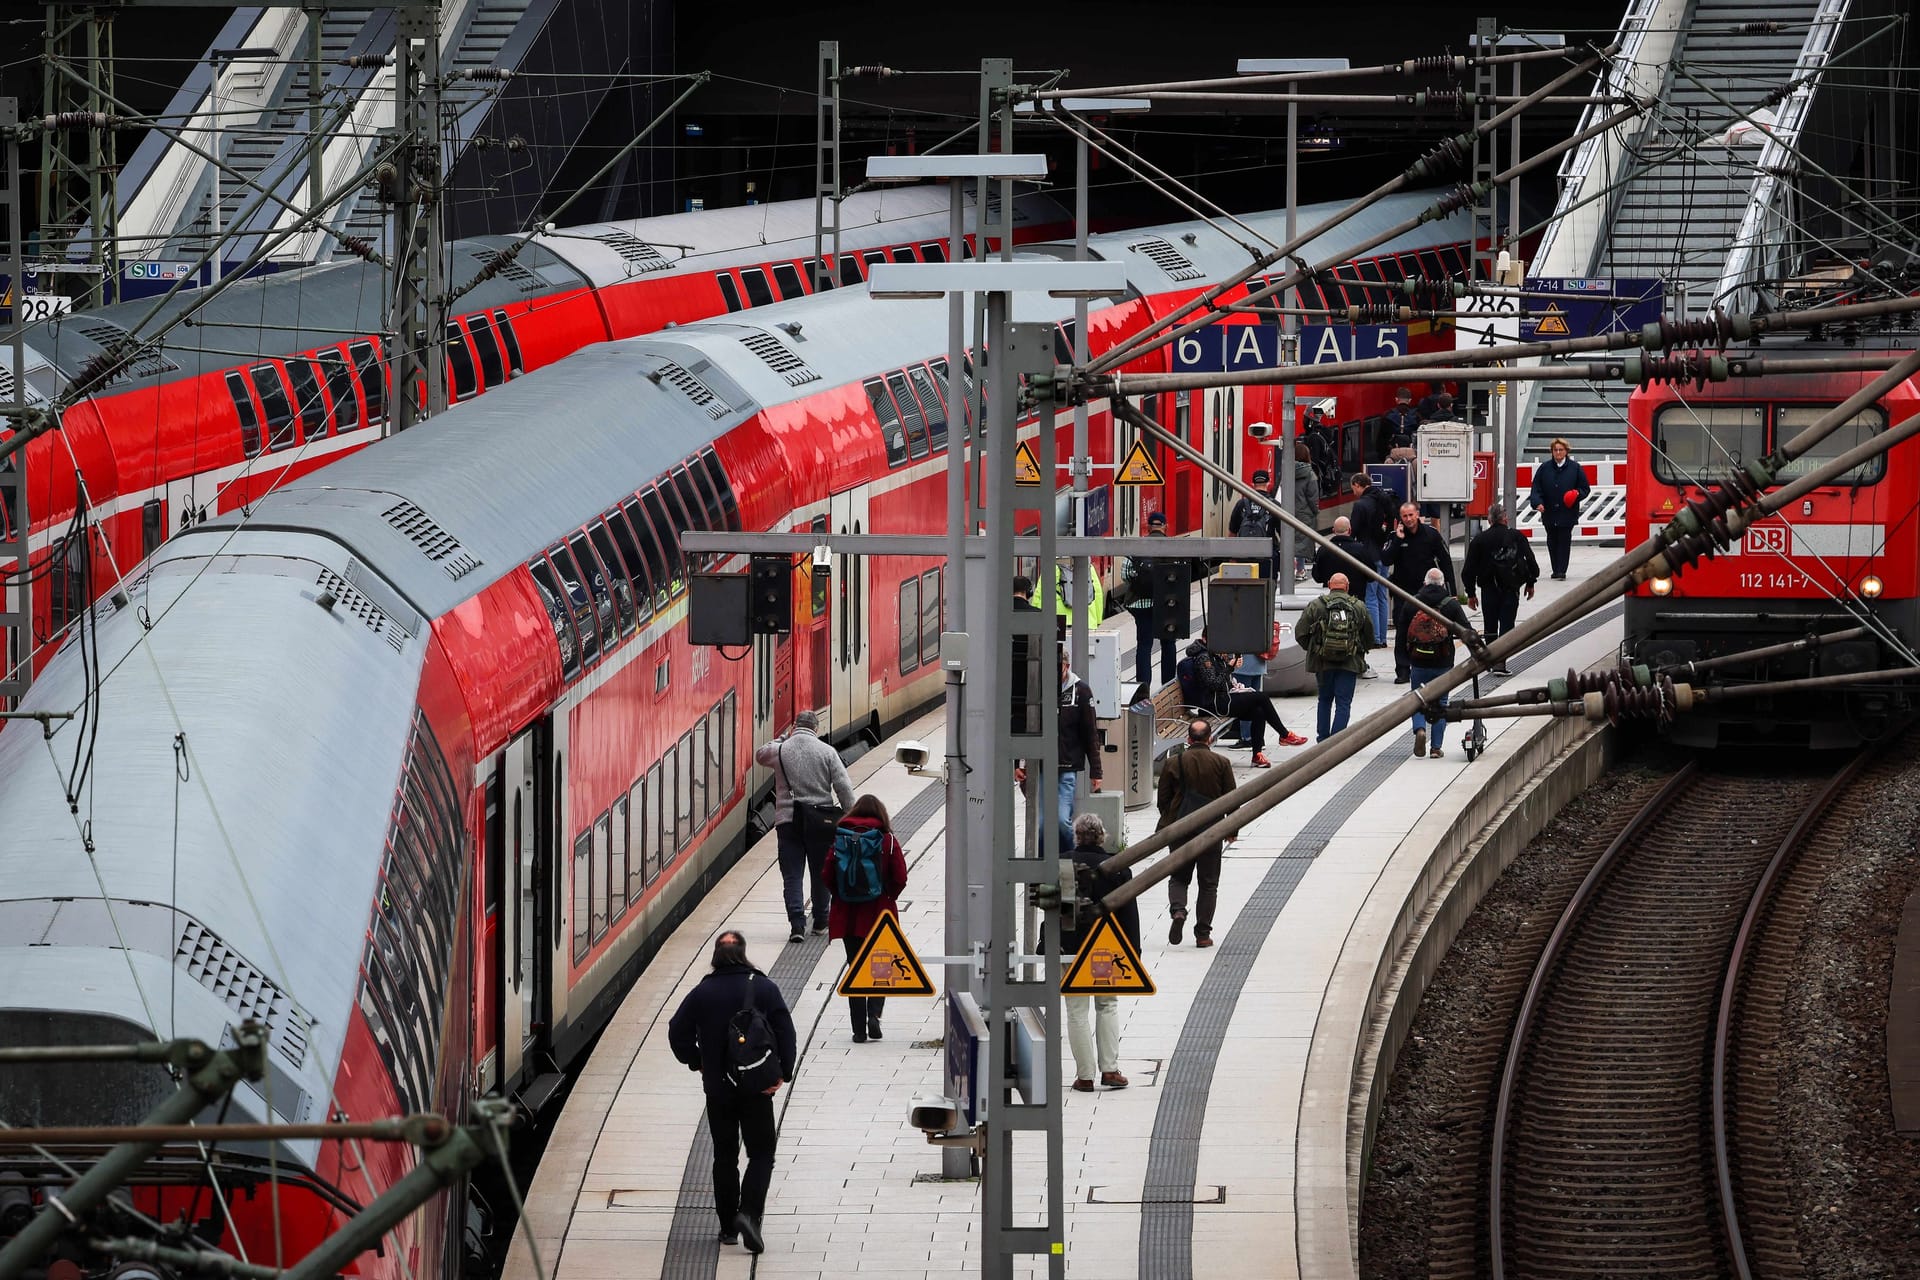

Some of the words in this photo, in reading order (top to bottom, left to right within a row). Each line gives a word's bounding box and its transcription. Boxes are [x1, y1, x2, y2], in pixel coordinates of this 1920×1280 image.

[1537, 280, 1558, 290] 7-14
[1178, 329, 1201, 365] 6
[1234, 326, 1264, 364] A
[1313, 327, 1344, 364] A
[1375, 327, 1399, 358] 5
[1478, 323, 1497, 347] 4
[1750, 529, 1783, 551] DB
[1740, 573, 1763, 588] 112
[1768, 573, 1810, 588] 141-7
[1131, 740, 1139, 793] Abfall
